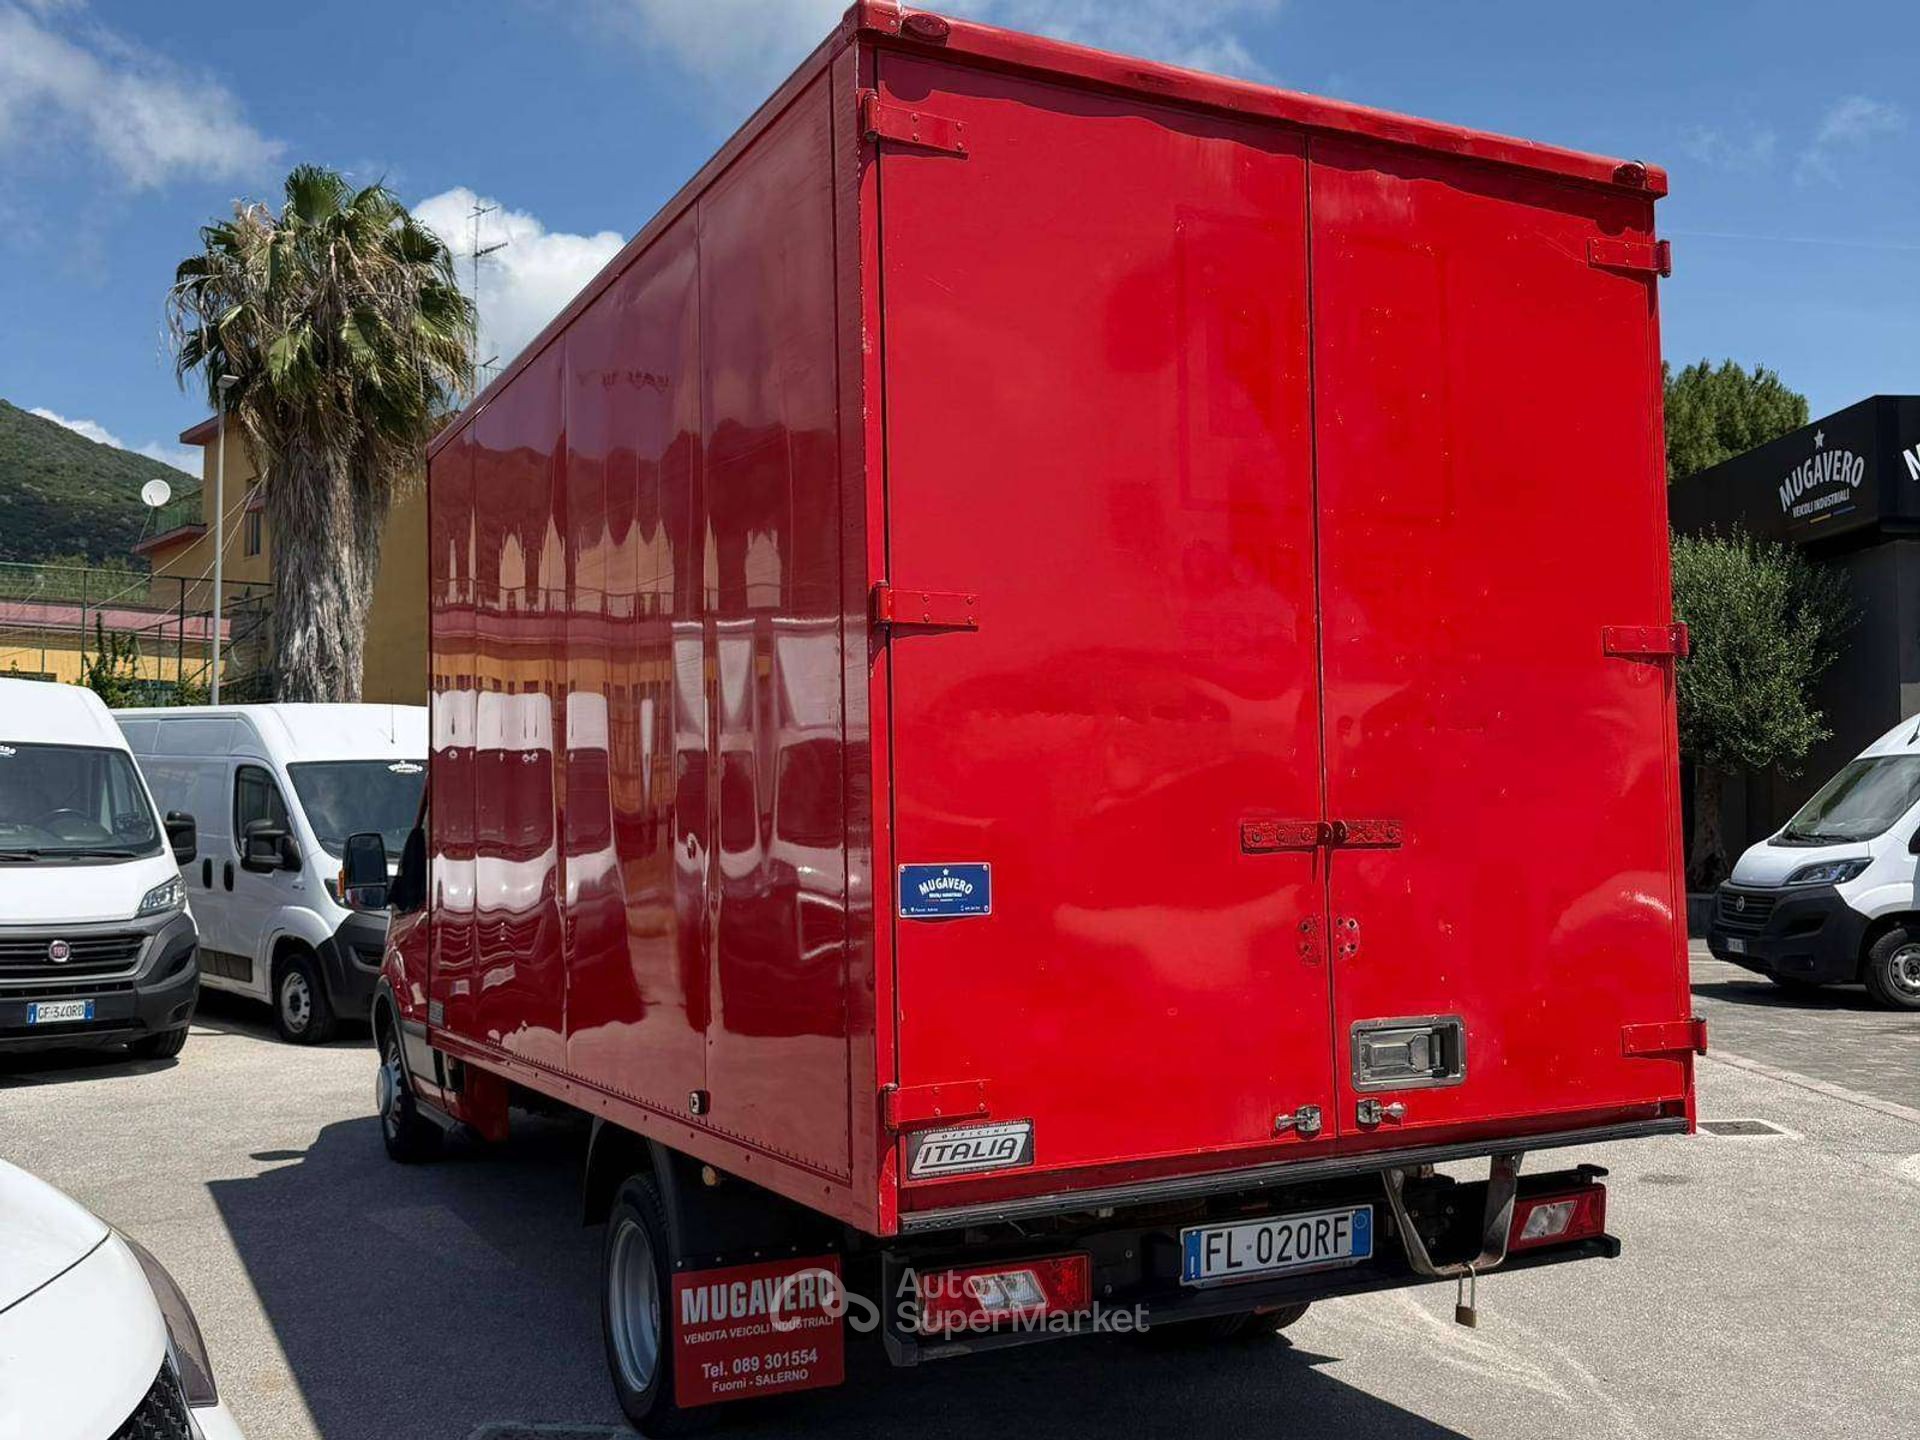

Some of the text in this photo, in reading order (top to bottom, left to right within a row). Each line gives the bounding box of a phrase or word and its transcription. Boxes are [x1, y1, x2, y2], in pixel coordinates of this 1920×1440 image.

[1779, 450, 1865, 512] MUGAVERO
[918, 877, 973, 895] MUGAVERO
[921, 1137, 1018, 1164] ITALIA
[681, 1270, 835, 1325] MUGAVERO
[684, 1315, 834, 1345] VENDITA VEICOLI INDUSTRIALI
[702, 1348, 818, 1379] Tel. 089 301554
[712, 1377, 747, 1393] Fuorni
[755, 1368, 808, 1386] SALERNO
